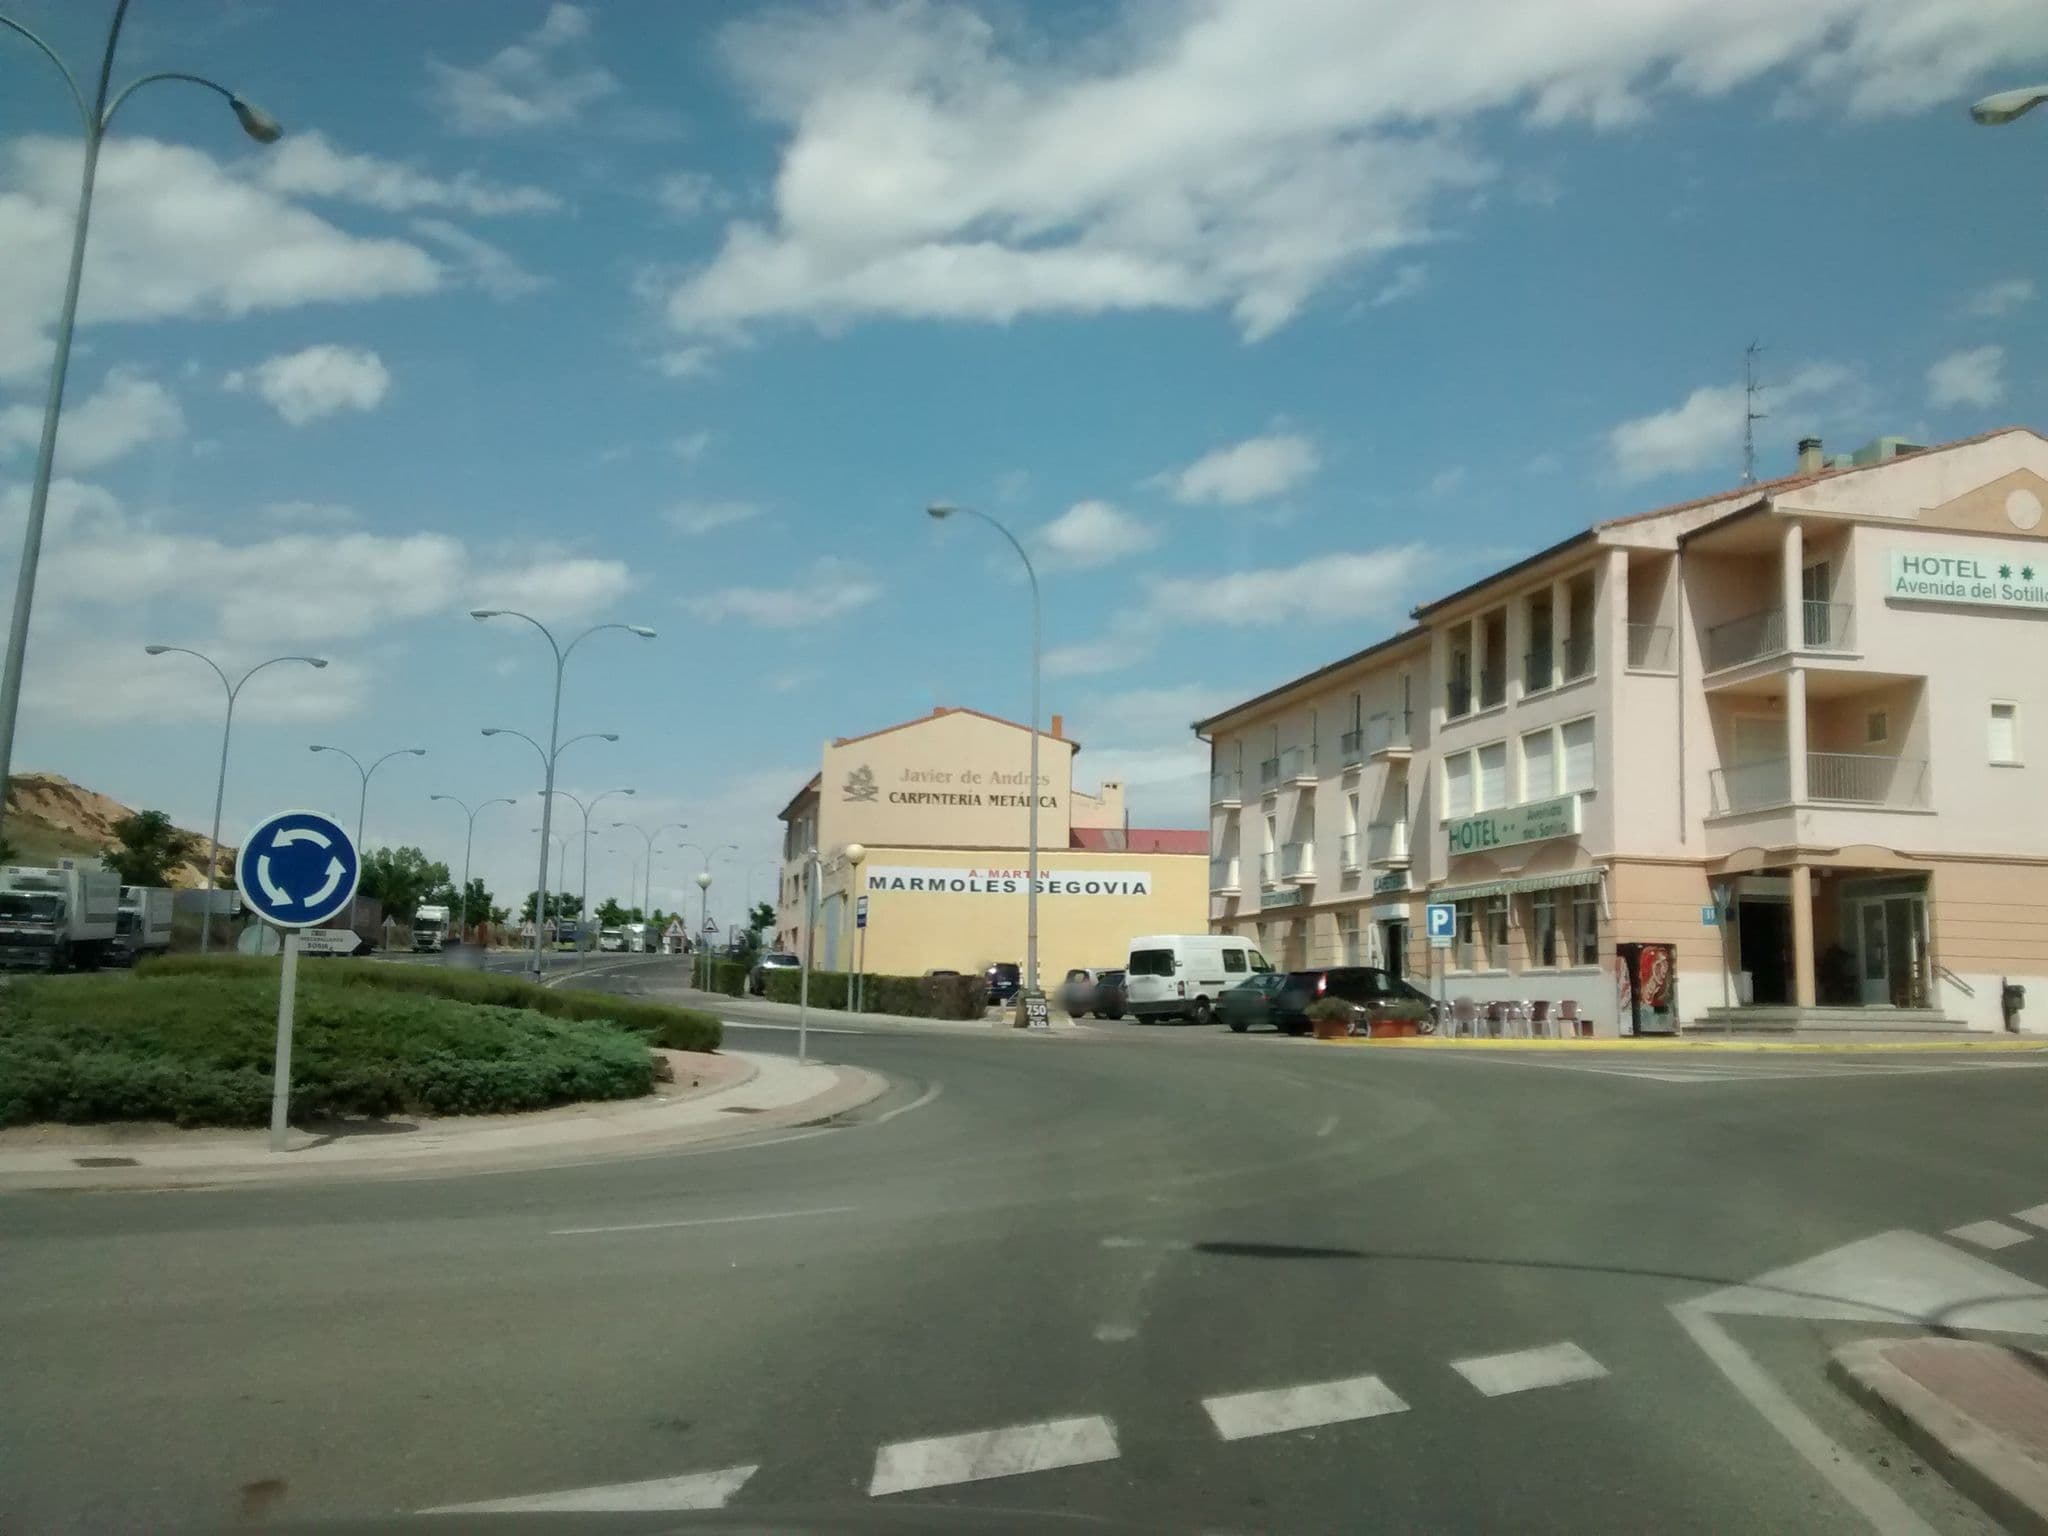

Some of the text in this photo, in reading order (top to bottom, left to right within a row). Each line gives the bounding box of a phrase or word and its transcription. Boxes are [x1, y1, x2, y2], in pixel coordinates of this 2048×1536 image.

[1903, 556, 1986, 579] HOTEL
[1896, 577, 1966, 597] Avenida
[1971, 583, 1996, 599] del
[900, 768, 953, 783] Javier
[960, 770, 982, 785] de
[889, 790, 1057, 808] CARPINTERÍA METÁLCA
[1448, 819, 1500, 852] HOTEL
[988, 870, 1050, 879] MARTN
[868, 877, 1147, 895] MARMOLES SEGOVIA
[1432, 909, 1449, 935] P
